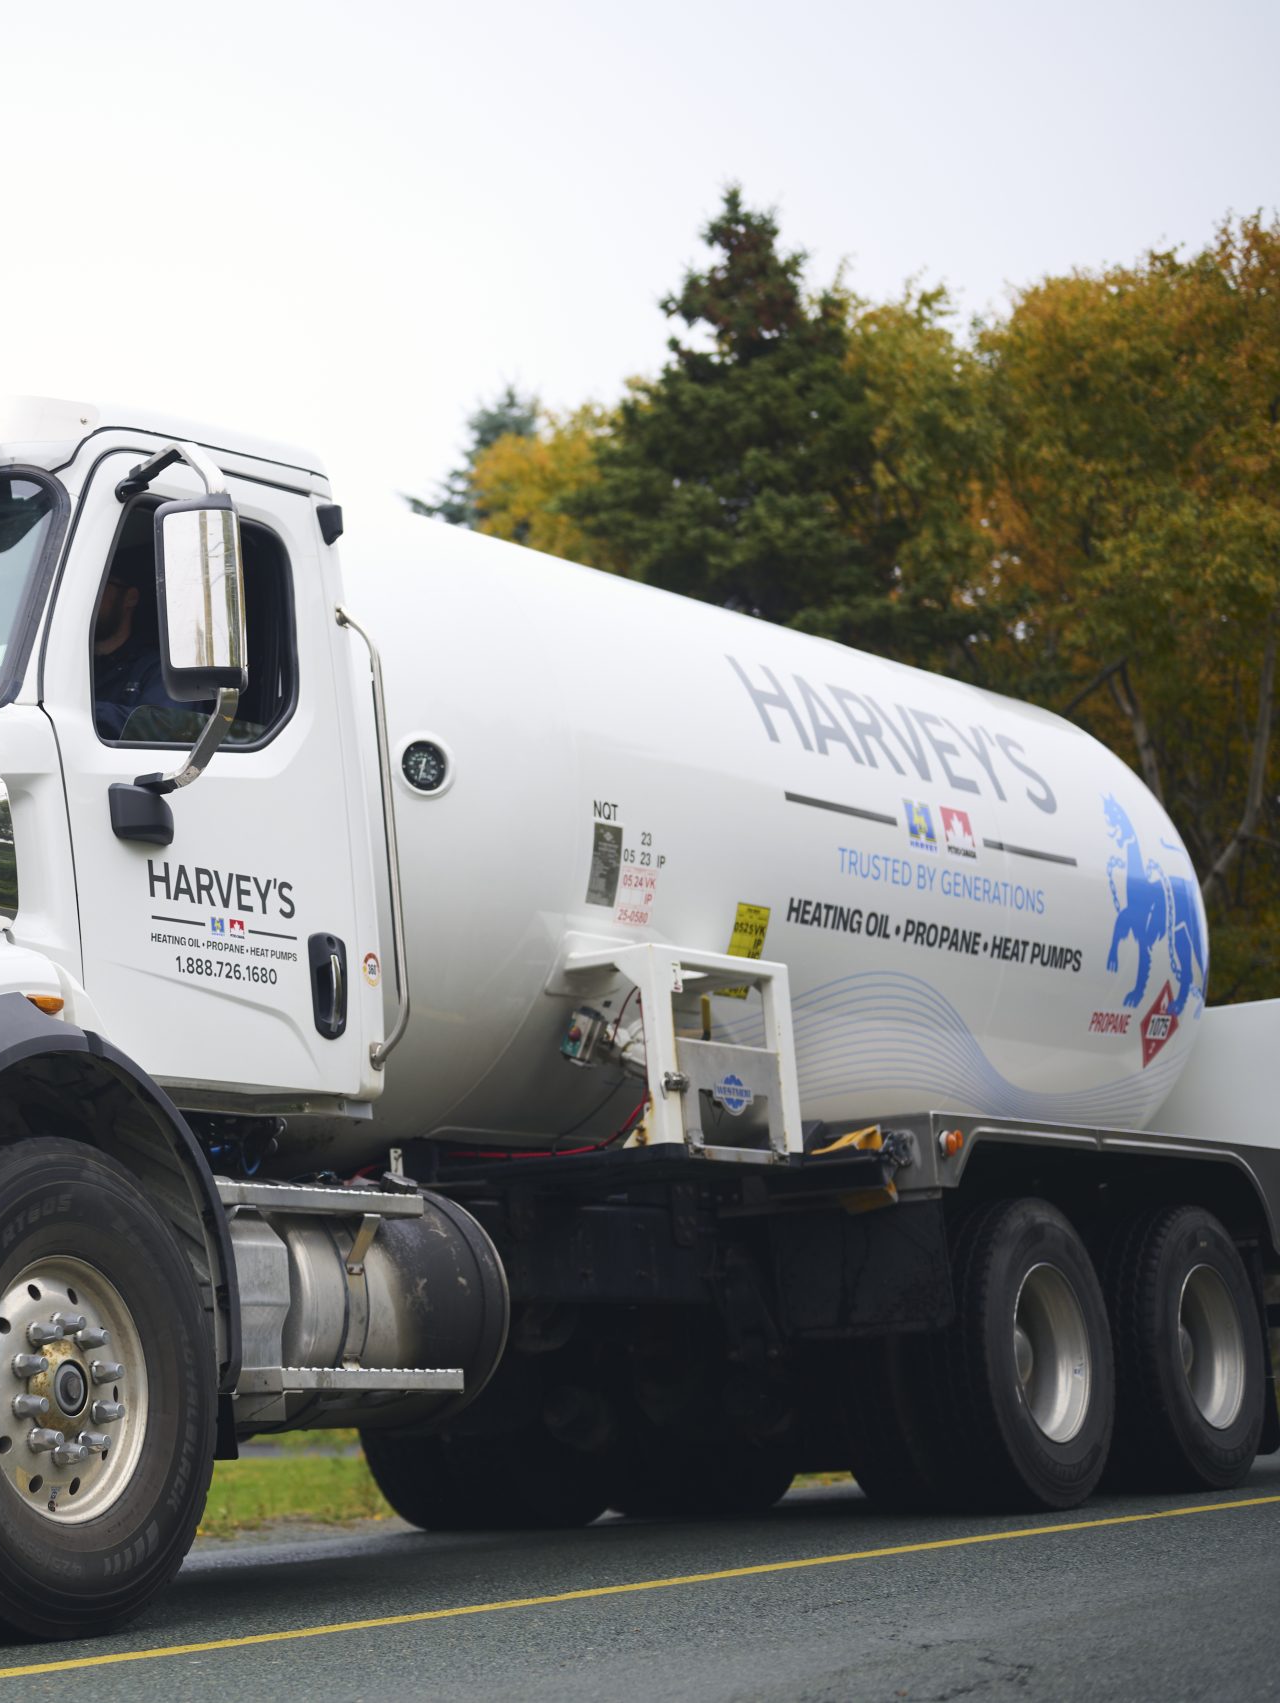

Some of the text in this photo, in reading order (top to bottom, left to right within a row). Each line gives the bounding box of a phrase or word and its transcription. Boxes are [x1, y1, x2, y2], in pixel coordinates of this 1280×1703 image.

[724, 653, 1058, 815] HARVEY'S
[593, 800, 619, 822] NQT
[641, 832, 652, 847] 23
[623, 849, 666, 869] 05 23 IP
[147, 859, 296, 919] HARVEY'S
[838, 847, 1046, 915] TRUSTED BY GENERATIONS
[151, 933, 298, 962] HEATING OIL PROPANE HEAT PUMPS
[786, 897, 1083, 972] HEATING OIL PROPANE HEAT PUMPS
[175, 955, 278, 985] 1.888.726.1680
[1088, 1011, 1132, 1035] PROPANE
[1148, 1017, 1170, 1037] 1075
